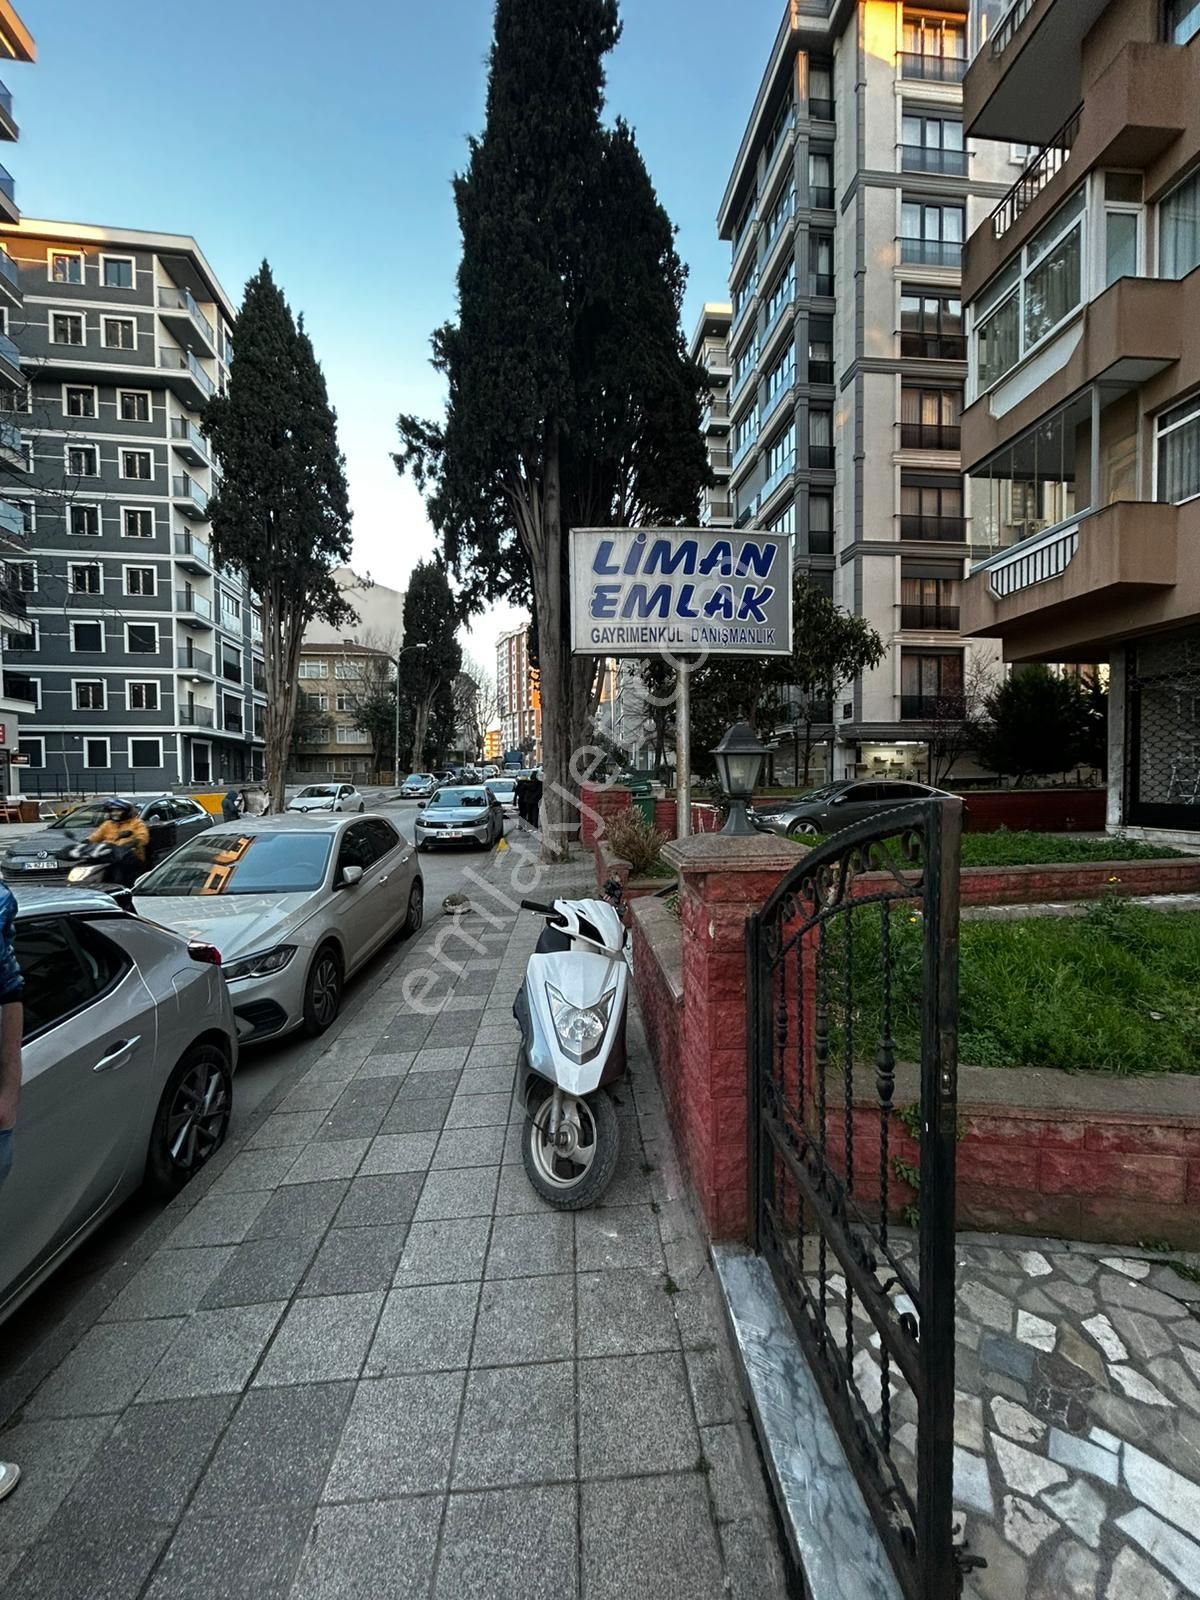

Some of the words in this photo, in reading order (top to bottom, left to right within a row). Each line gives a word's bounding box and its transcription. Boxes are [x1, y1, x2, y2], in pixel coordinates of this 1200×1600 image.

[592, 532, 777, 578] LİMAN
[590, 583, 775, 623] EMLAK
[591, 626, 684, 644] GAYRIMENKUL
[691, 626, 776, 647] DANIŞMANLIK
